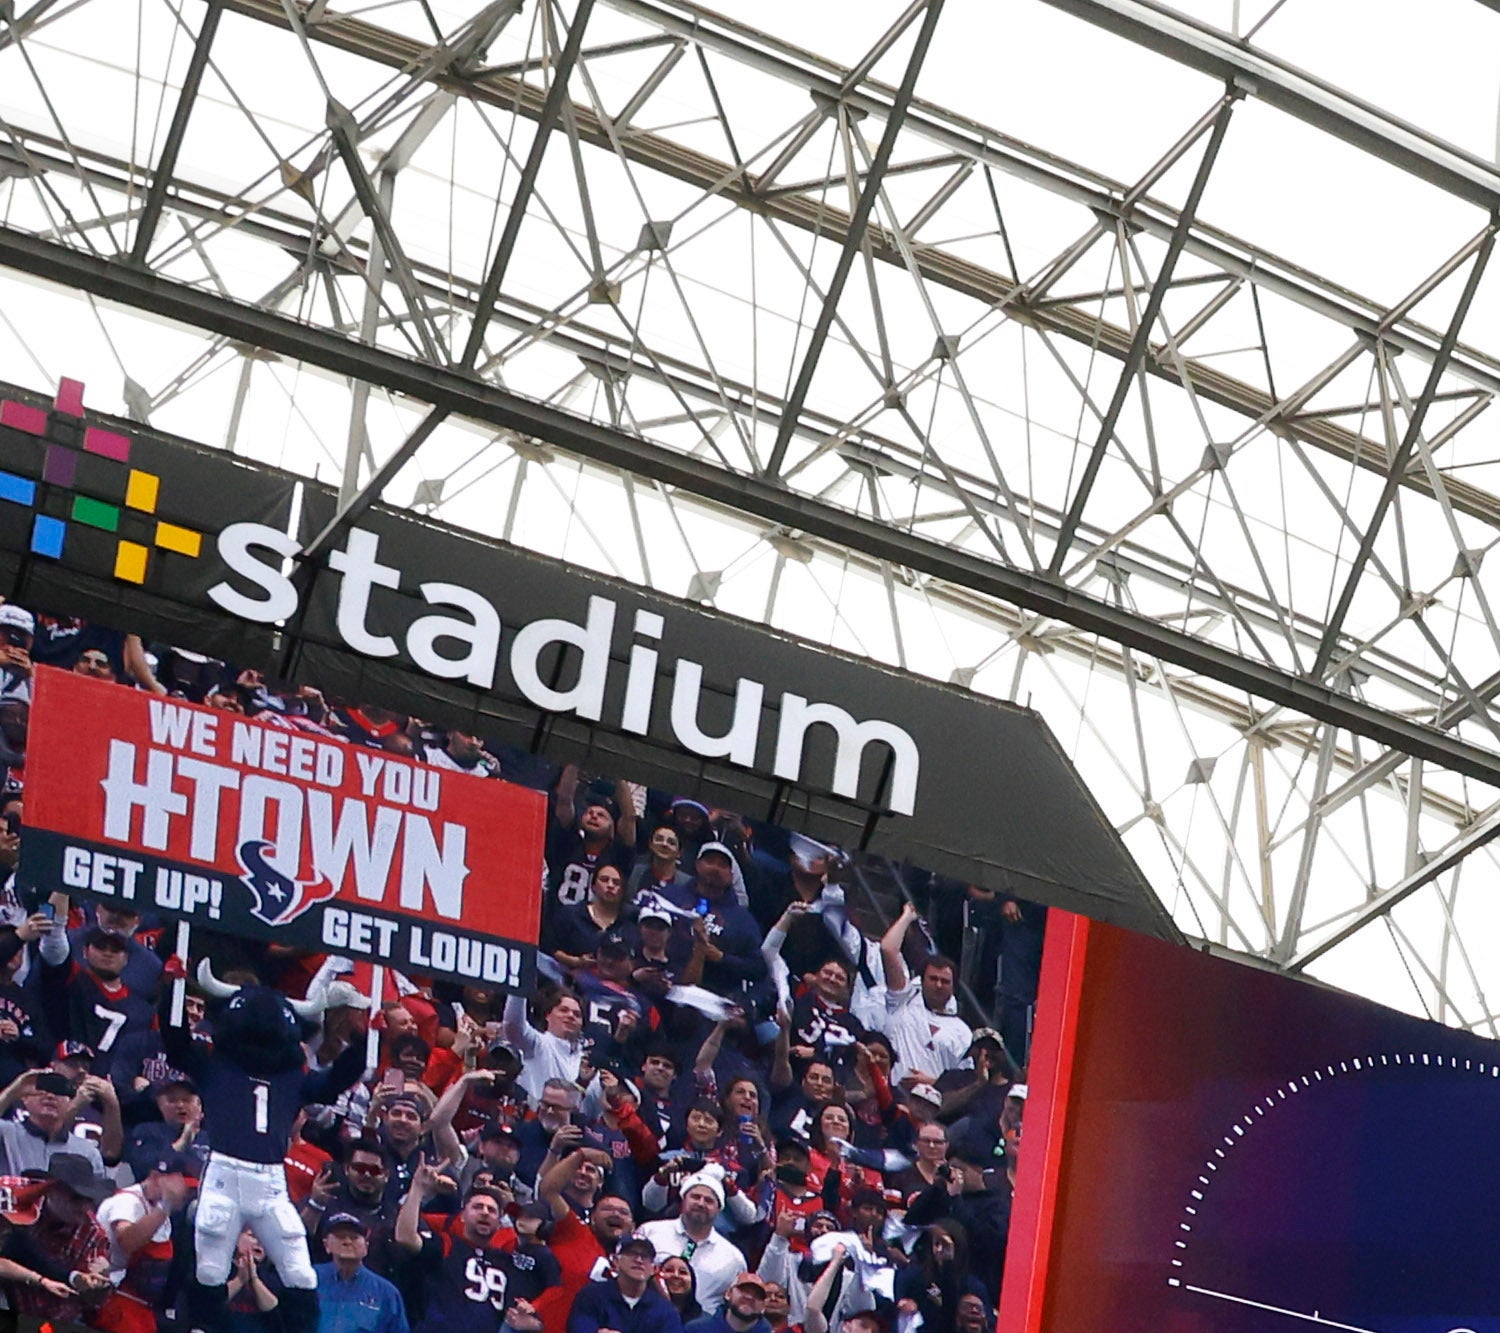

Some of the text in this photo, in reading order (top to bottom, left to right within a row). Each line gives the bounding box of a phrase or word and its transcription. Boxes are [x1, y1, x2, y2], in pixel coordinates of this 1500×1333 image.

[208, 523, 921, 817] stadium
[150, 700, 440, 812] WE NEED YOU
[102, 739, 472, 921] HTOWN
[62, 846, 223, 919] GET UP!
[322, 906, 521, 988] GET LOUD!
[95, 1004, 126, 1052] 7
[253, 1085, 268, 1133] 1
[464, 1258, 507, 1311] 99
